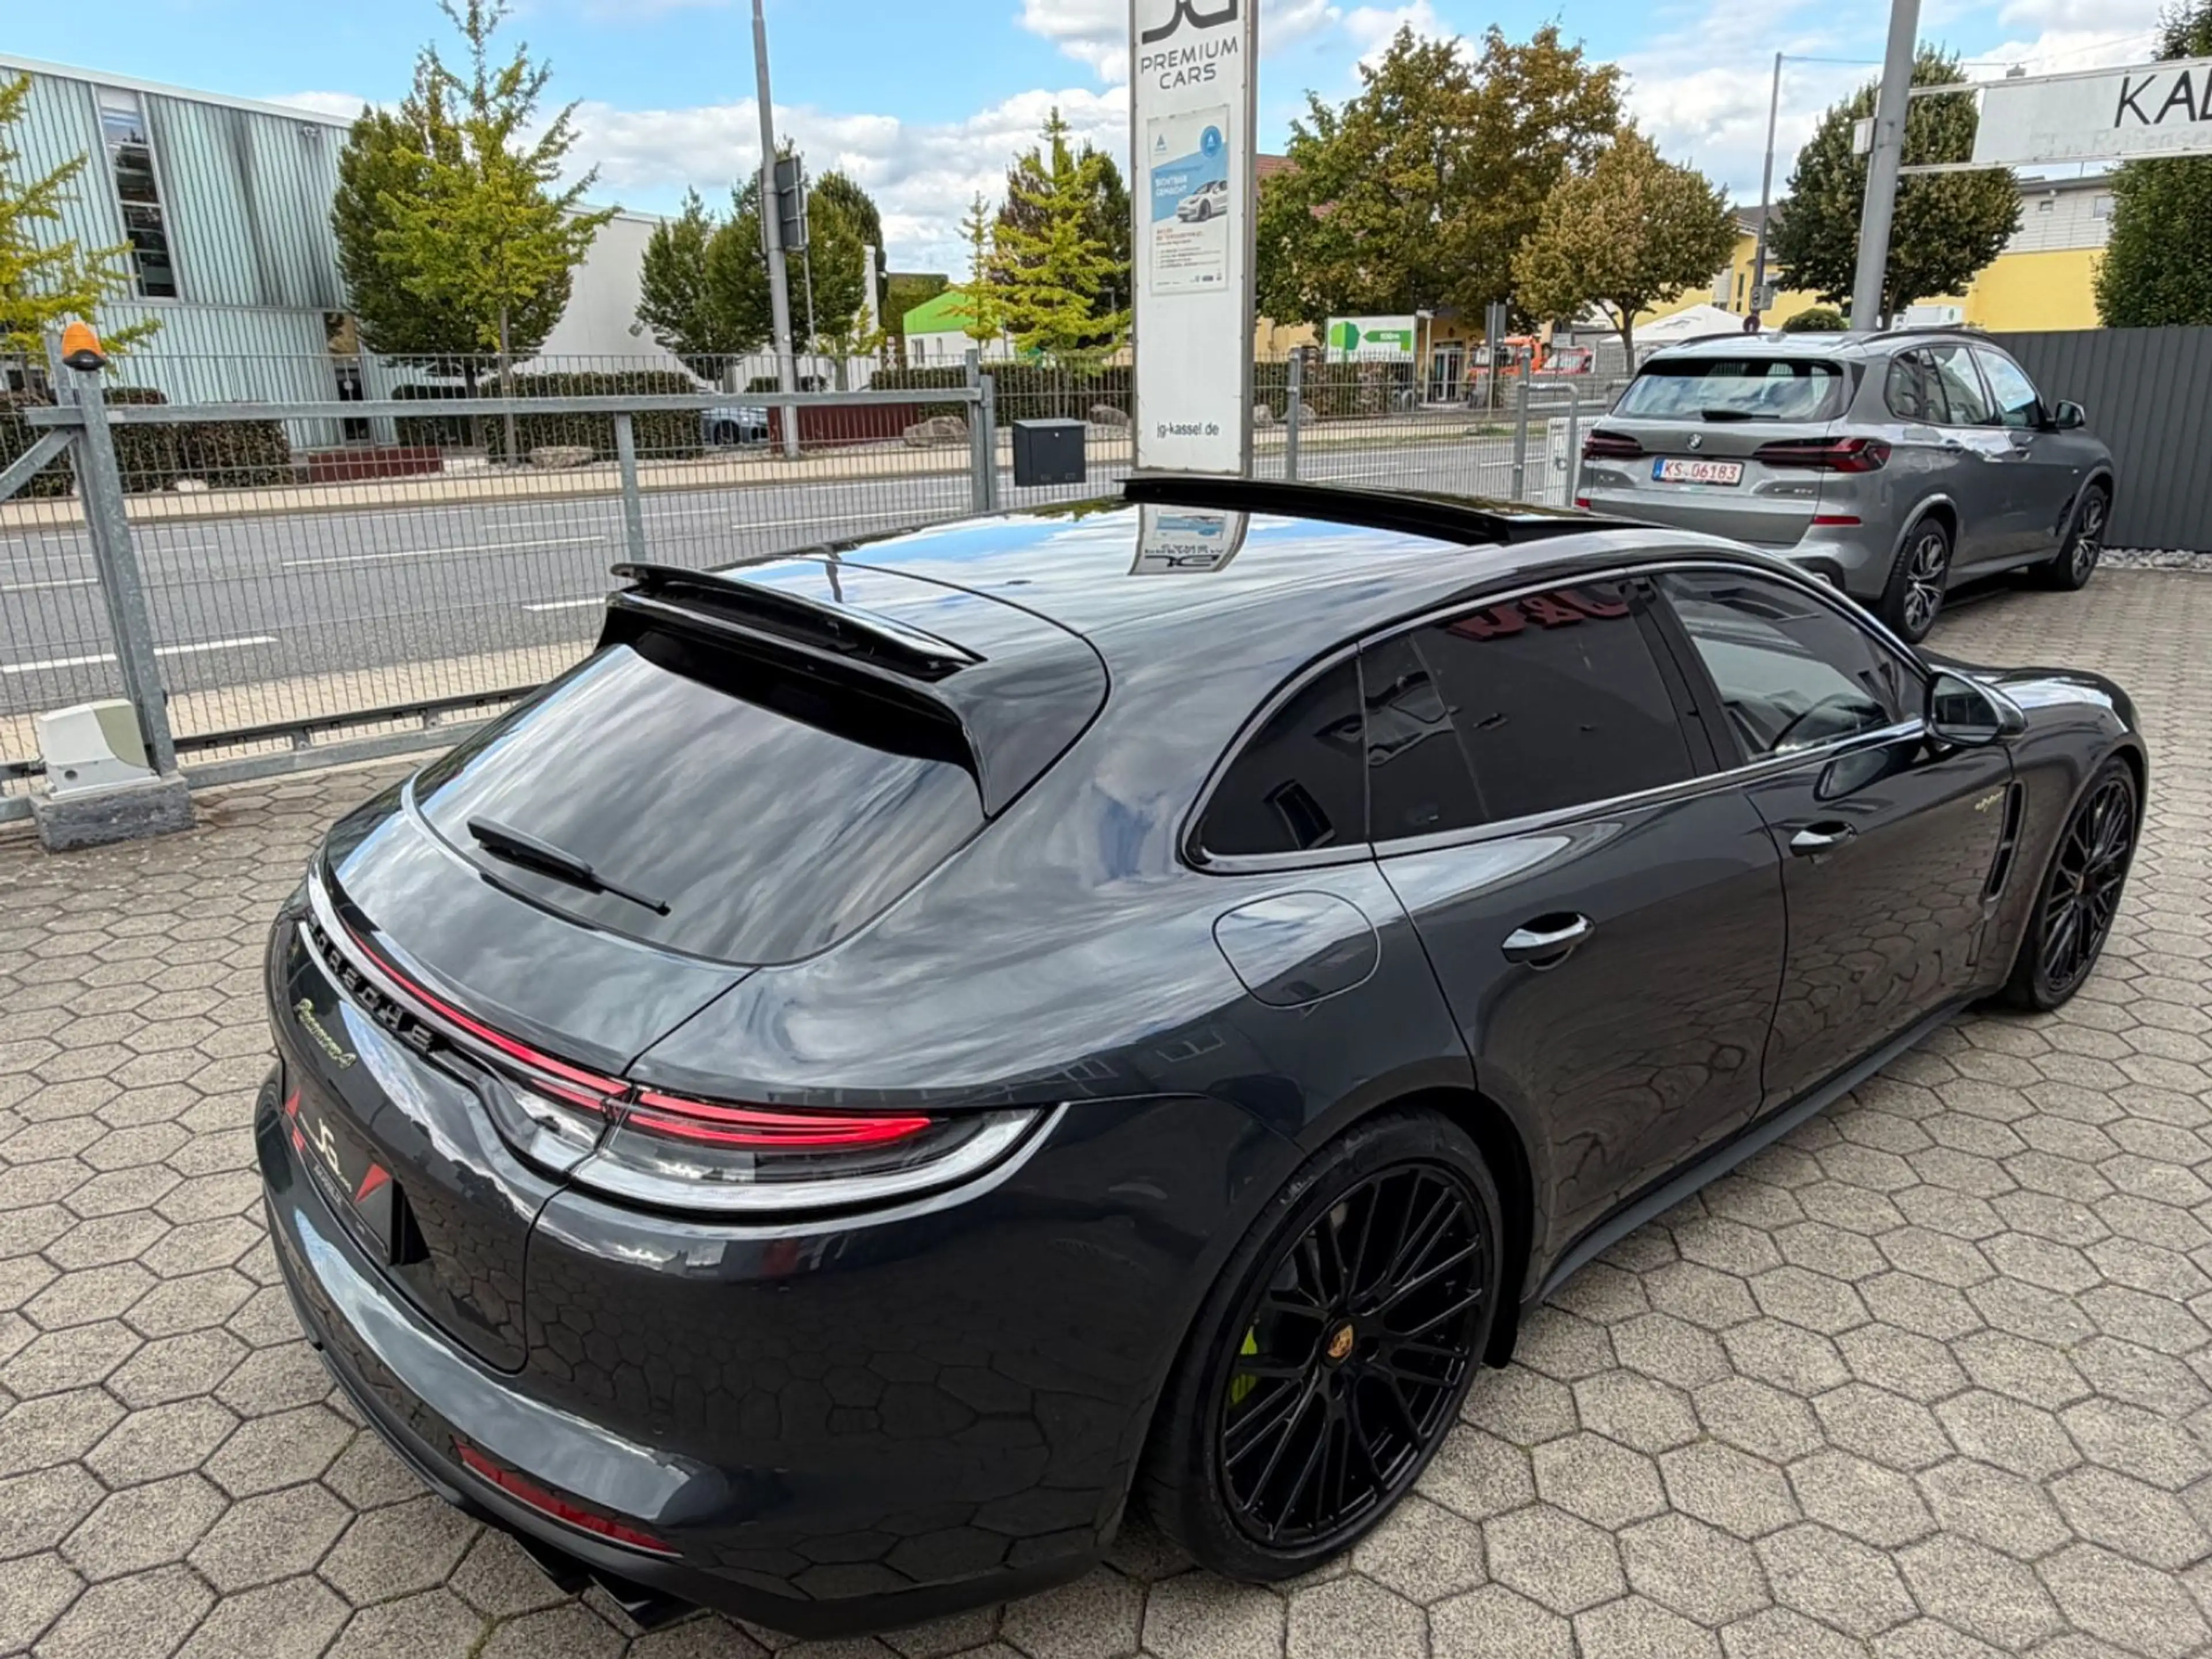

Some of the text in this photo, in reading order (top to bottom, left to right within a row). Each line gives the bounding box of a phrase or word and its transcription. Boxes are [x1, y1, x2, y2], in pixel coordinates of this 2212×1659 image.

[1141, 36, 1238, 74] PREMIUM
[1159, 62, 1217, 90] CARS
[1665, 463, 1737, 480] KS 06183
